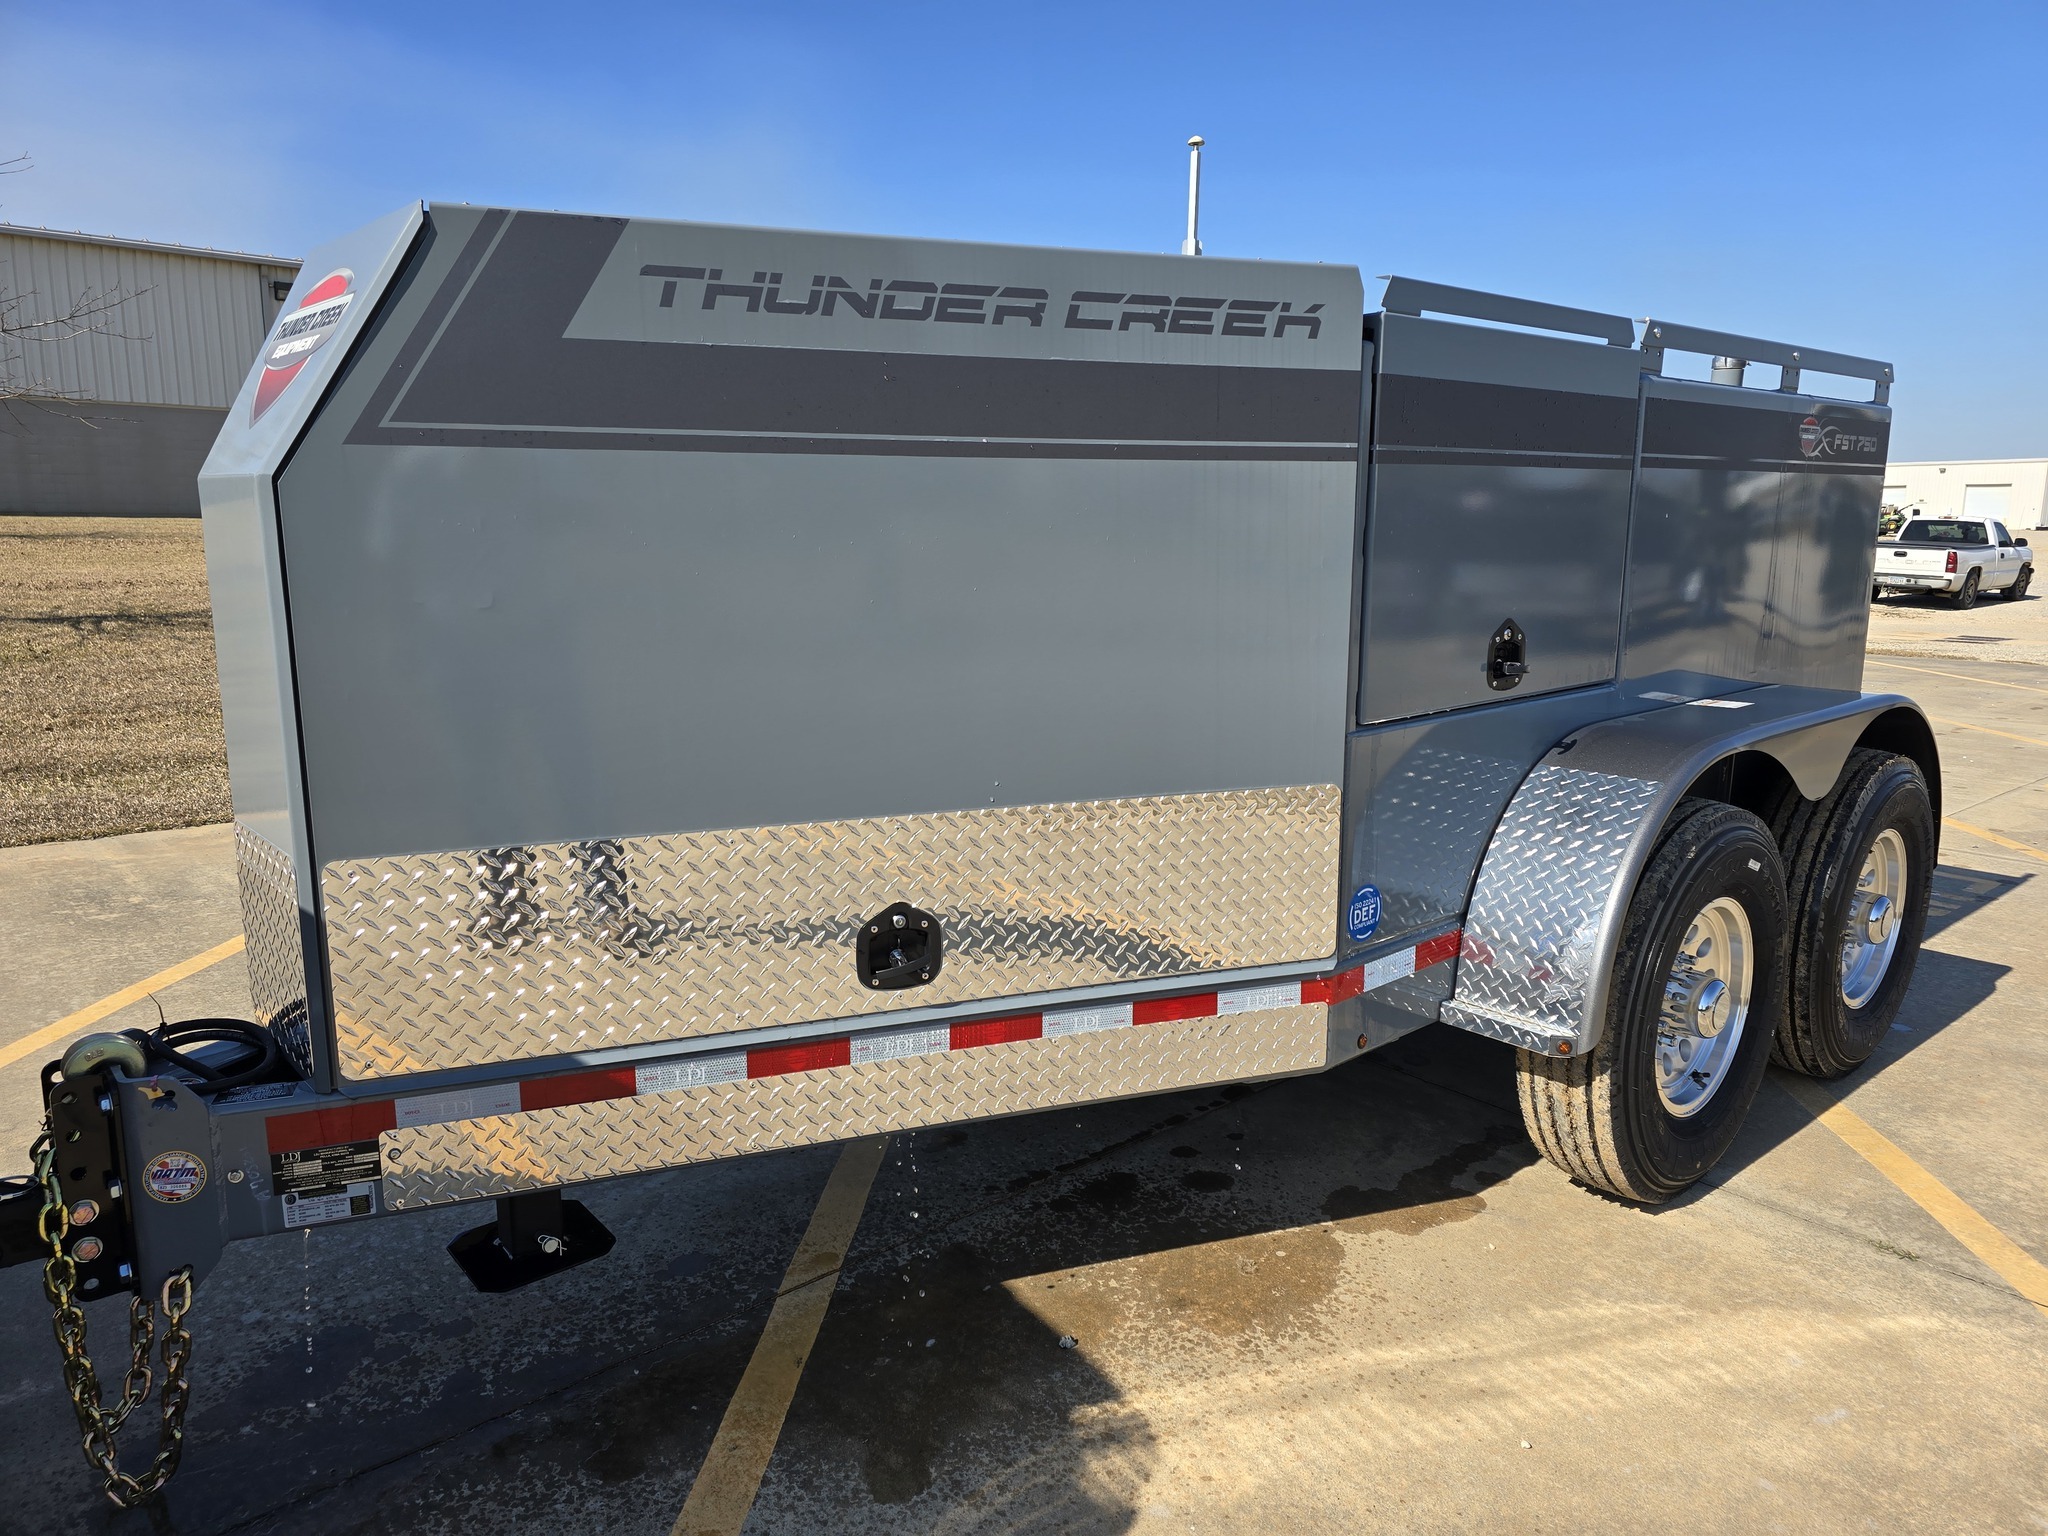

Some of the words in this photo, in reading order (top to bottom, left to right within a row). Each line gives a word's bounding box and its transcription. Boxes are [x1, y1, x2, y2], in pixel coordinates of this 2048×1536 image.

[640, 264, 1048, 328] THUNDER
[1064, 290, 1326, 339] CREEK
[273, 311, 318, 342] THUNDER
[309, 302, 349, 331] CREEK
[271, 334, 321, 359] EQUIPMENT
[1354, 904, 1376, 924] DEF
[1354, 918, 1376, 930] COMPLIANT
[1074, 1014, 1101, 1029] LDJ
[884, 1038, 913, 1054] LDJ
[675, 1066, 706, 1082] LDJ
[440, 1099, 475, 1116] LDJ
[281, 1151, 301, 1163] LDJ
[151, 1168, 197, 1179] NATM
